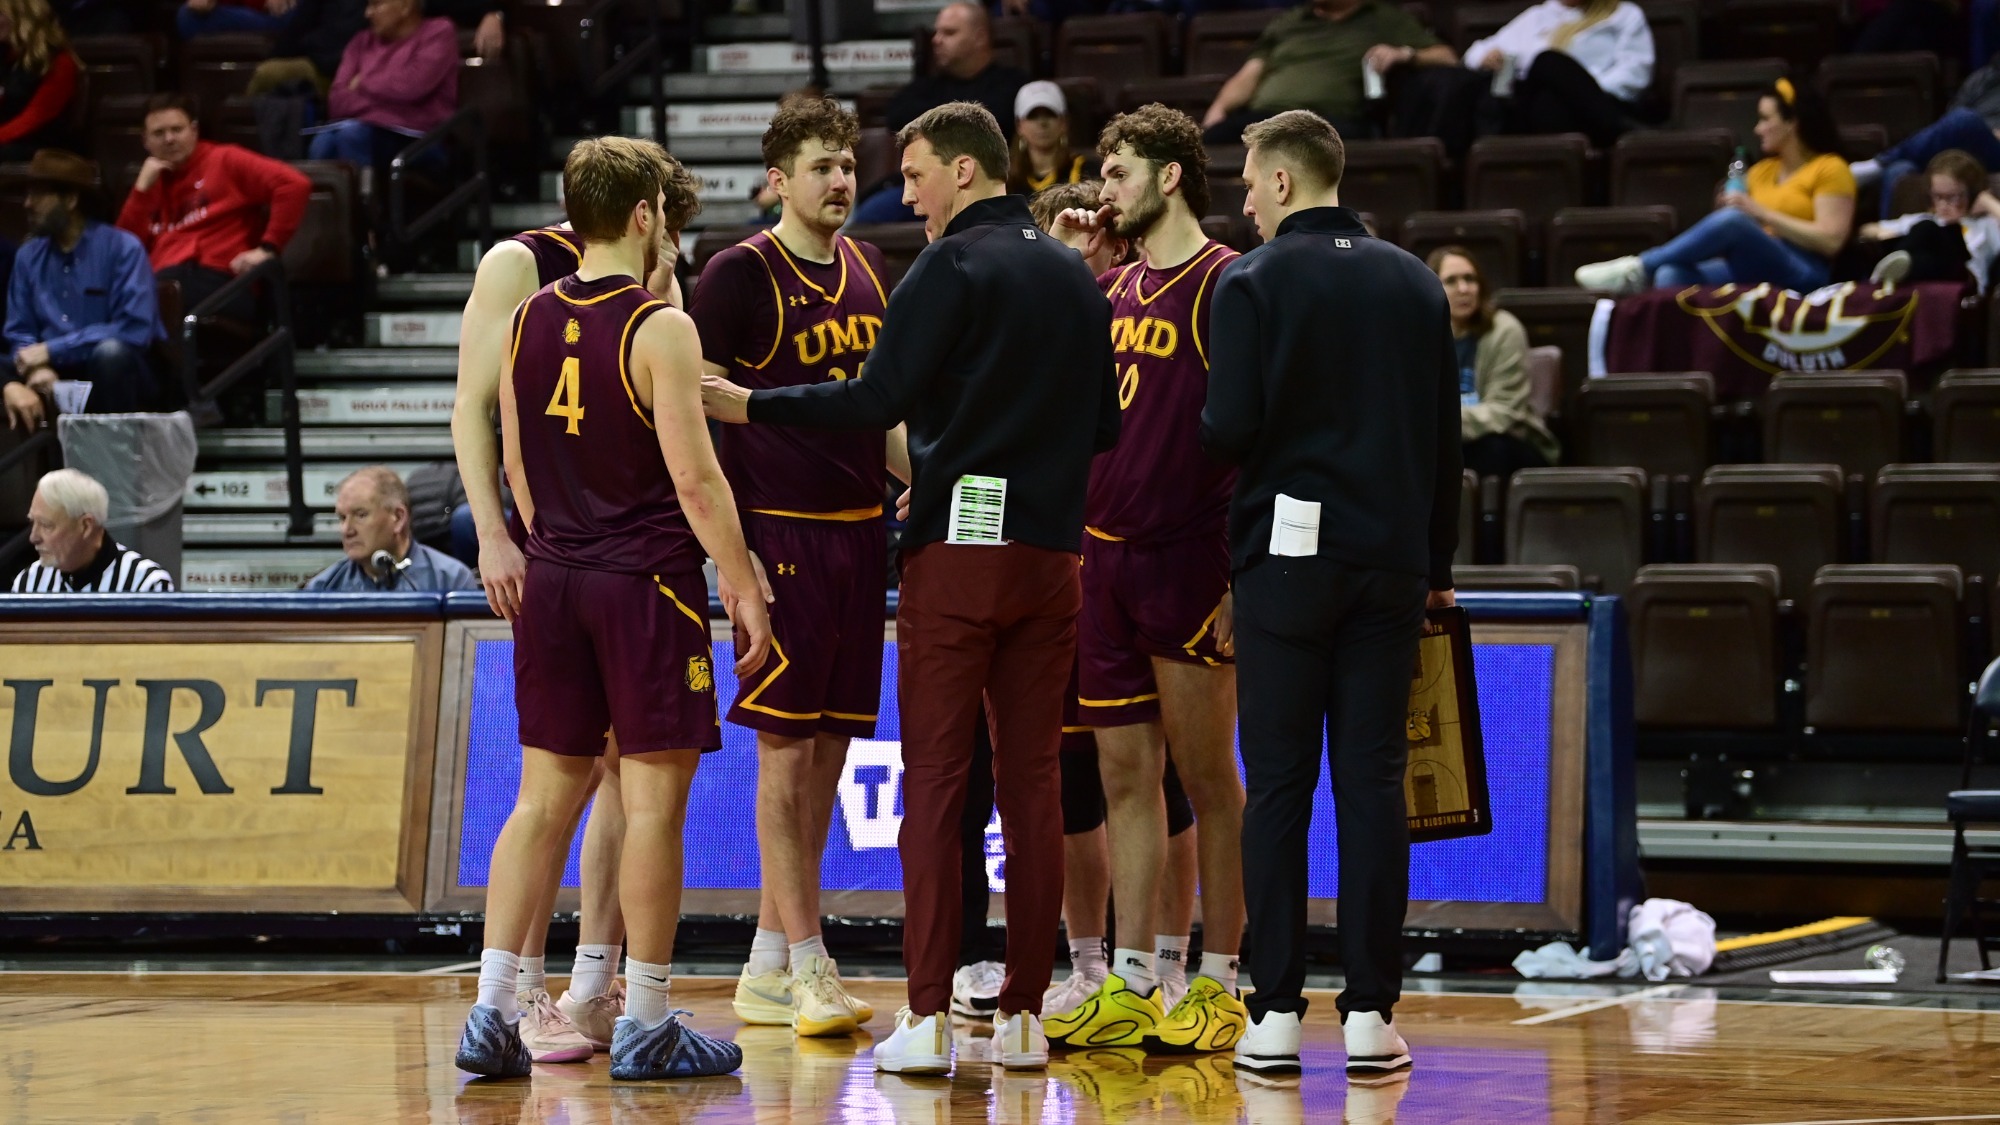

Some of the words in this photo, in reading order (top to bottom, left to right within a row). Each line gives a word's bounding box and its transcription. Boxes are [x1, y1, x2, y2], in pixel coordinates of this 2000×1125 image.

[545, 356, 585, 436] 4
[1115, 363, 1139, 410] 0
[222, 482, 249, 497] 102
[187, 572, 226, 585] FALLS
[230, 572, 263, 585] EAST
